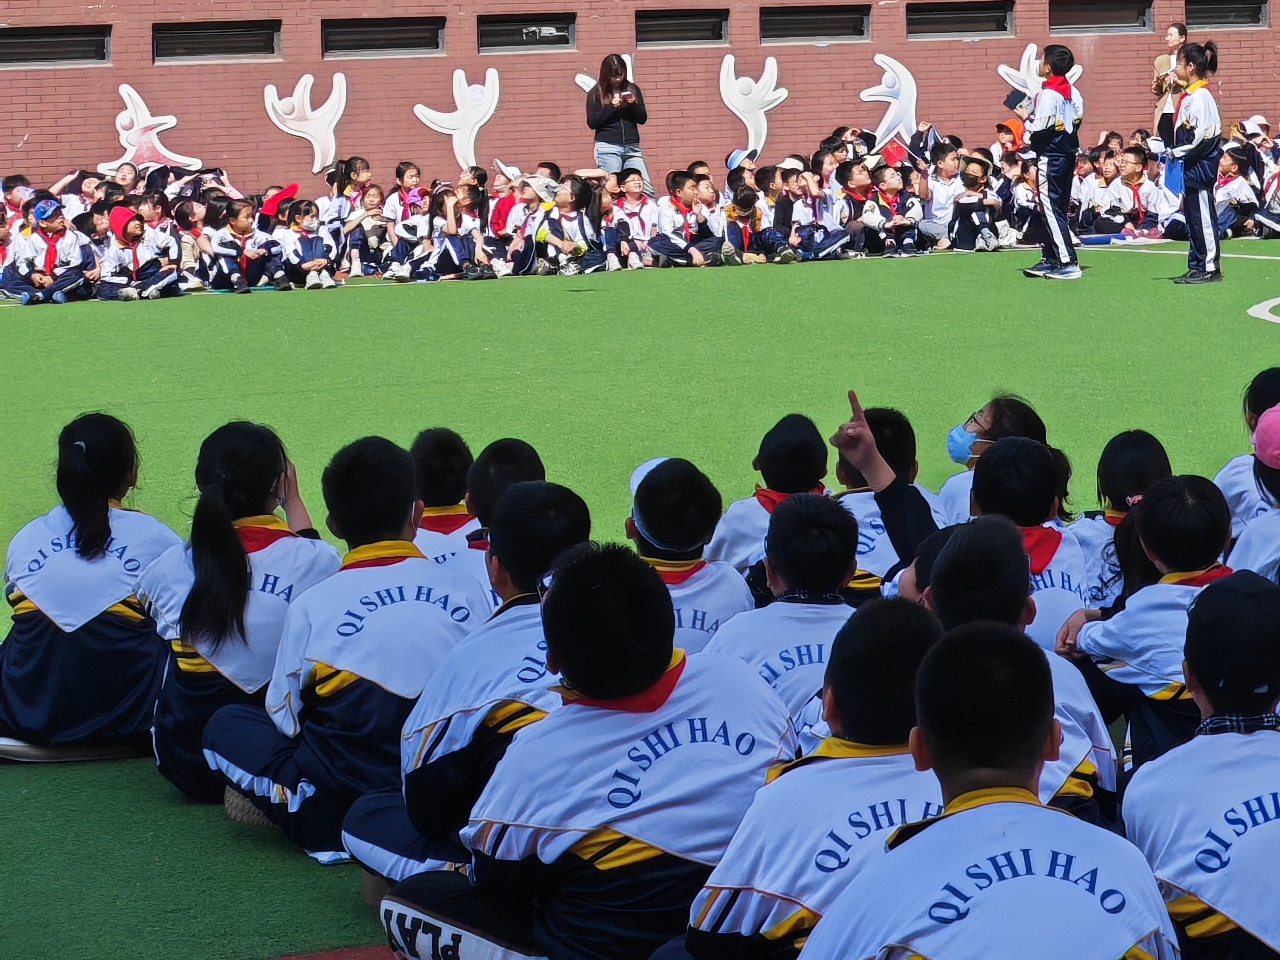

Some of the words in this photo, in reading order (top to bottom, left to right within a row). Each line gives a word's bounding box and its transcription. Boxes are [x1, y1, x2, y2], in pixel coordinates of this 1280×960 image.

[27, 548, 49, 573] QI
[50, 534, 81, 552] SH
[259, 572, 294, 605] HA
[1030, 568, 1057, 592] HI
[336, 609, 366, 637] QI
[359, 585, 407, 613] SHI
[413, 585, 470, 623] HAO
[690, 608, 720, 633] HA
[516, 655, 548, 684] QI
[779, 643, 825, 672] SHI
[607, 769, 641, 809] QI
[627, 722, 683, 772] SHI
[686, 717, 756, 756] HAO
[815, 828, 853, 873] QI
[847, 798, 908, 840] SHI
[1195, 826, 1234, 874] QI
[928, 881, 974, 925] QI
[965, 848, 1037, 891] SHI
[1045, 848, 1127, 915] HAO
